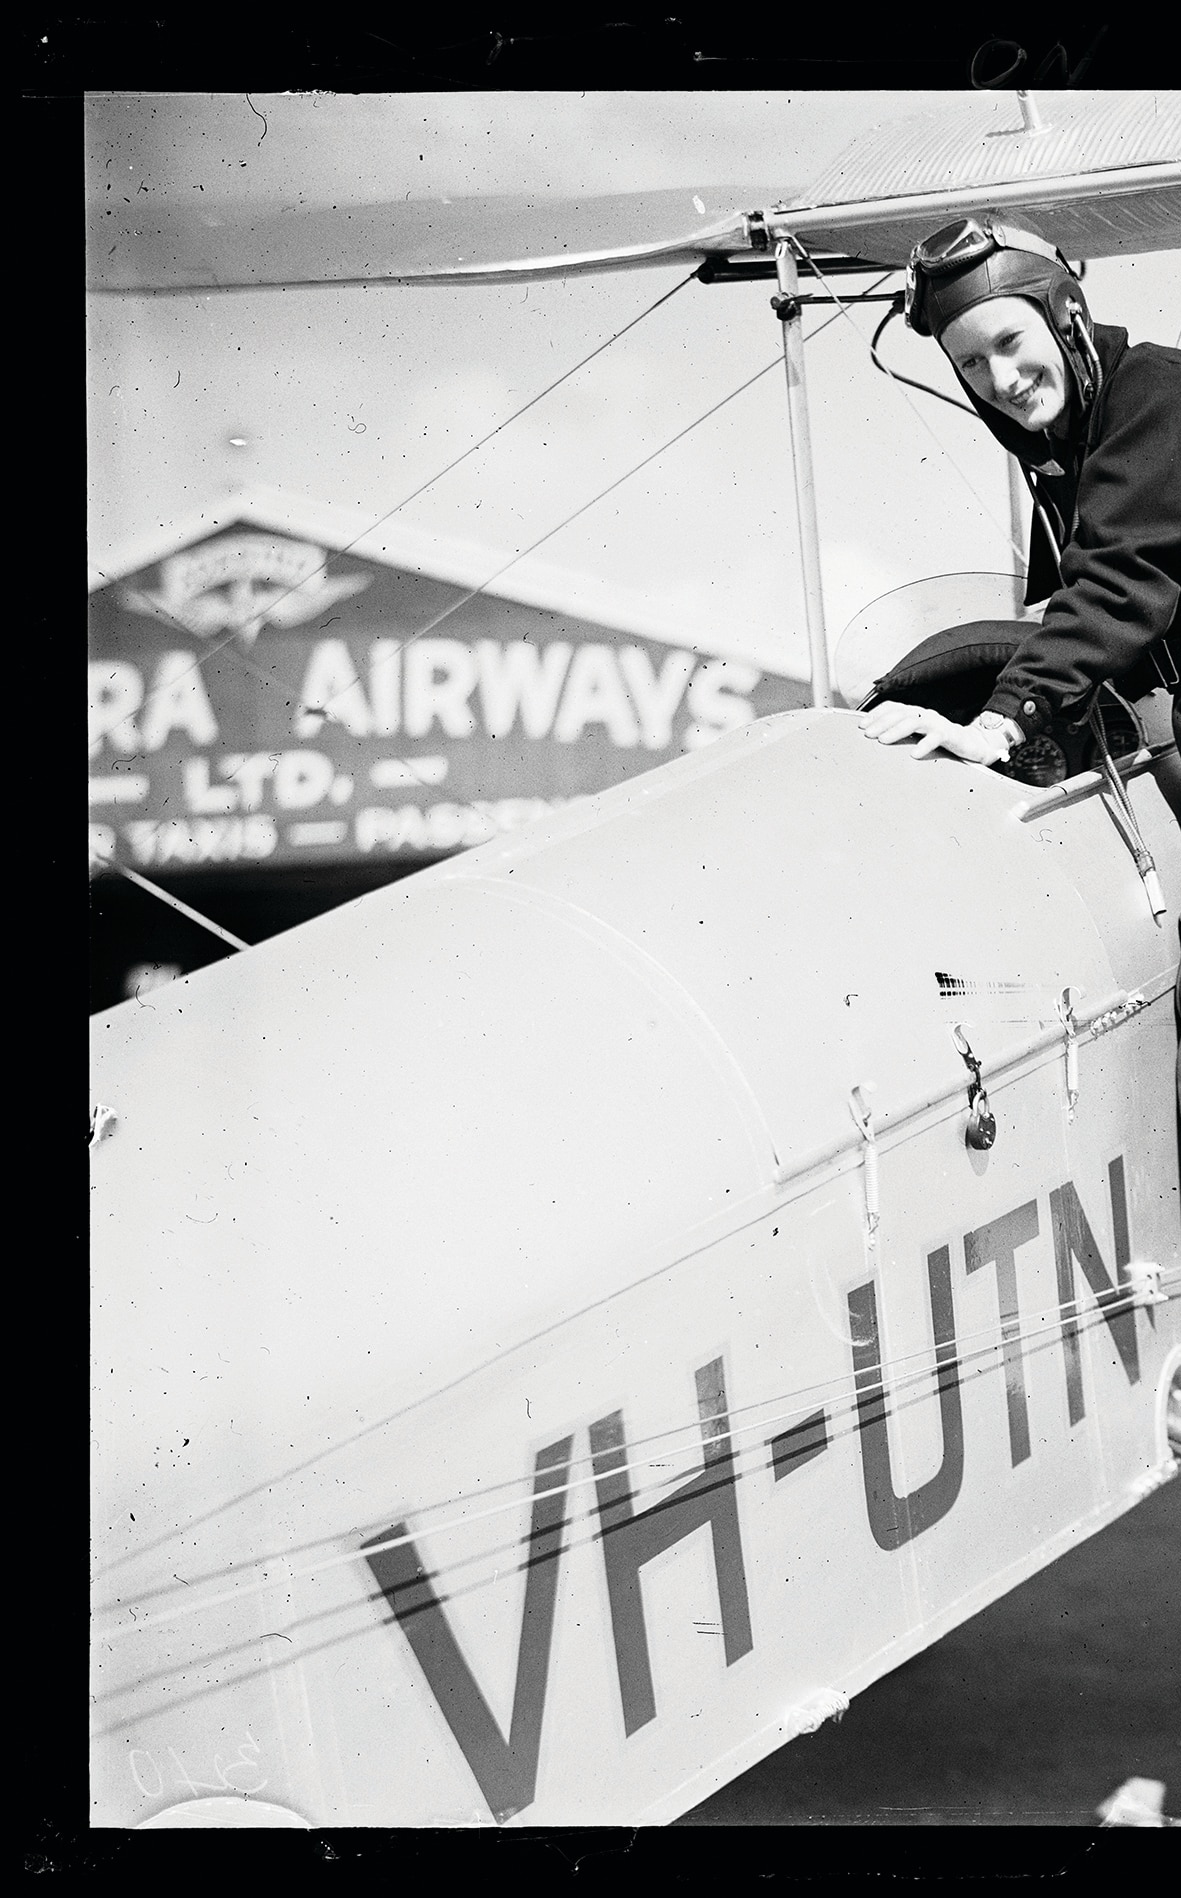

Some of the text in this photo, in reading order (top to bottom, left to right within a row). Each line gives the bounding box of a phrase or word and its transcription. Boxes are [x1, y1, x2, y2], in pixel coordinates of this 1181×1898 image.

[297, 638, 759, 752] AIRWAYS
[182, 748, 354, 814] LTD.
[359, 1153, 1159, 1826] VH-UTN
